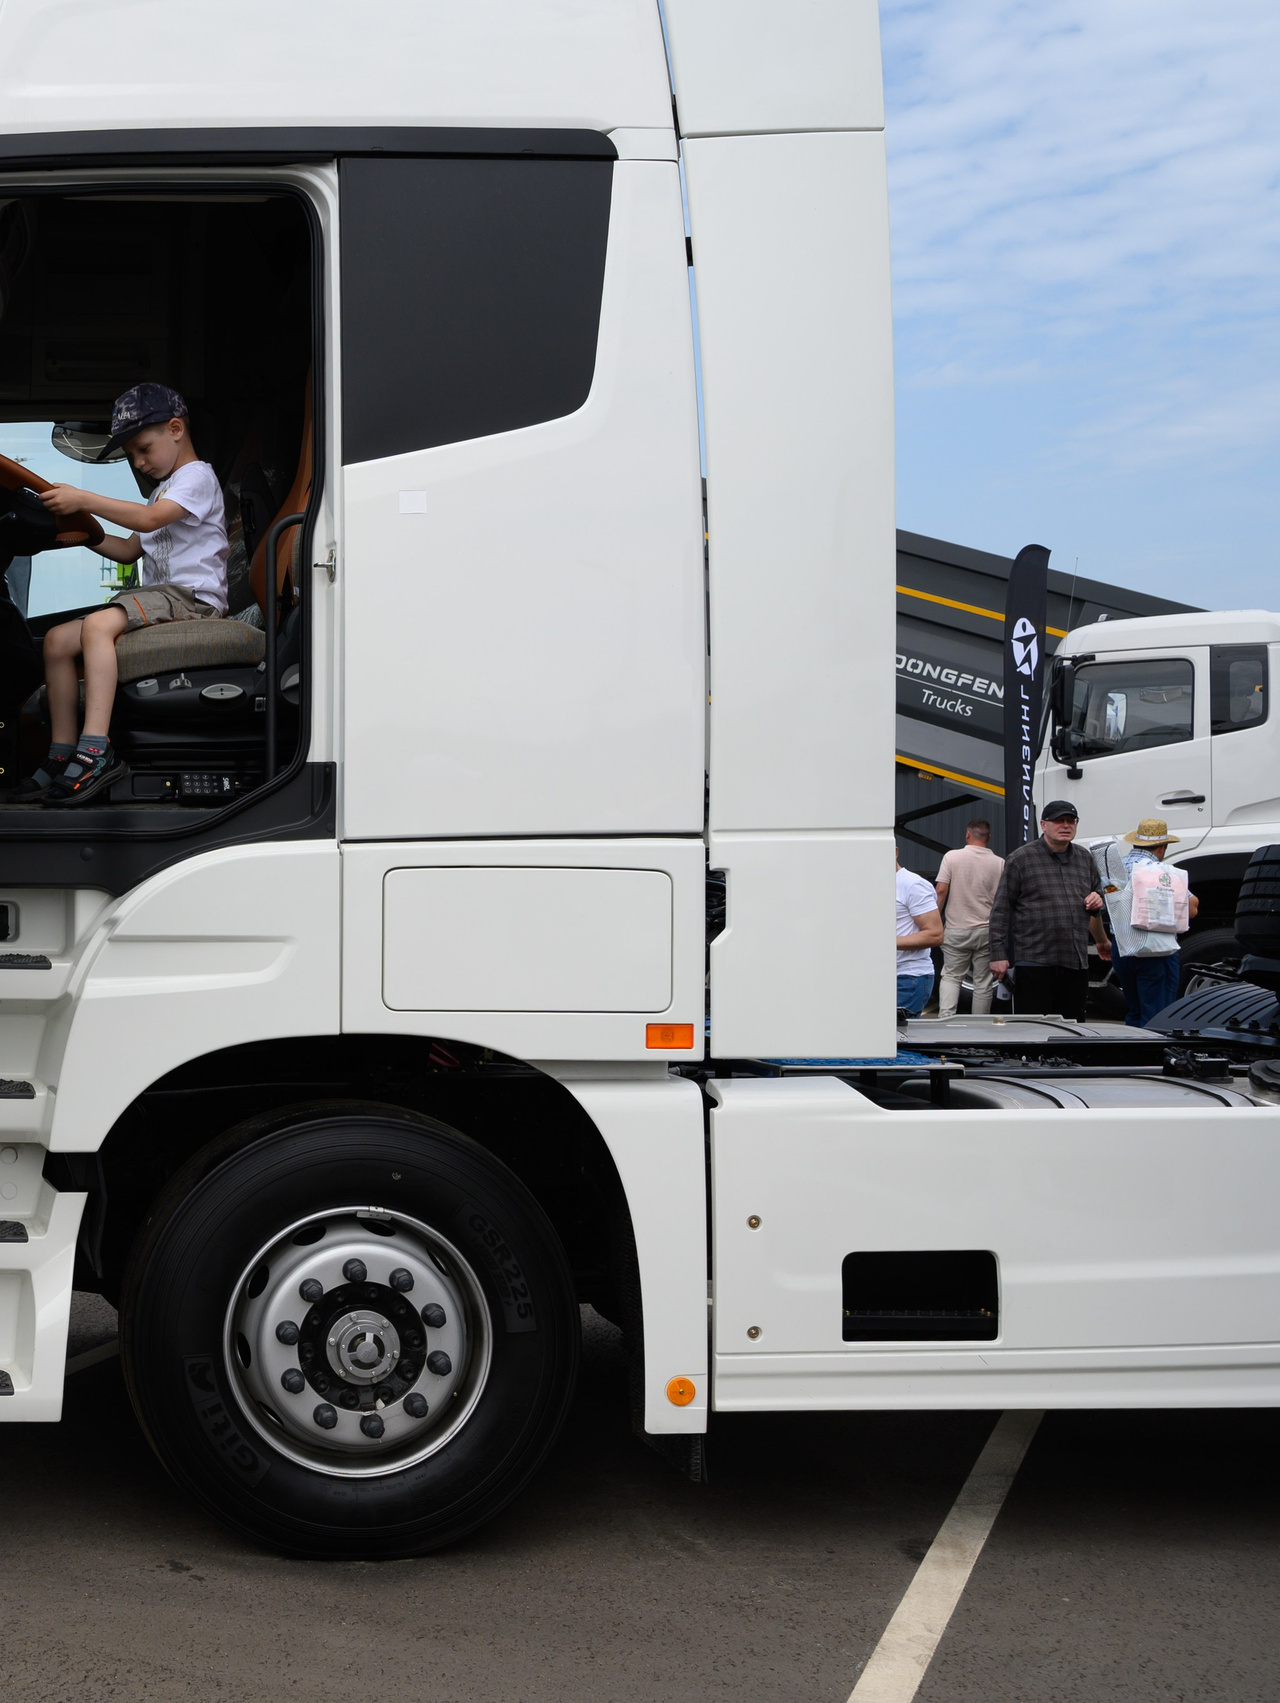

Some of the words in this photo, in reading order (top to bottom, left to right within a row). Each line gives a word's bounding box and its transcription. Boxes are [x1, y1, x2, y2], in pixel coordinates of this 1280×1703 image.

[922, 689, 974, 717] Trucks
[469, 1213, 533, 1319] GSR225
[201, 1402, 260, 1472] Giti
